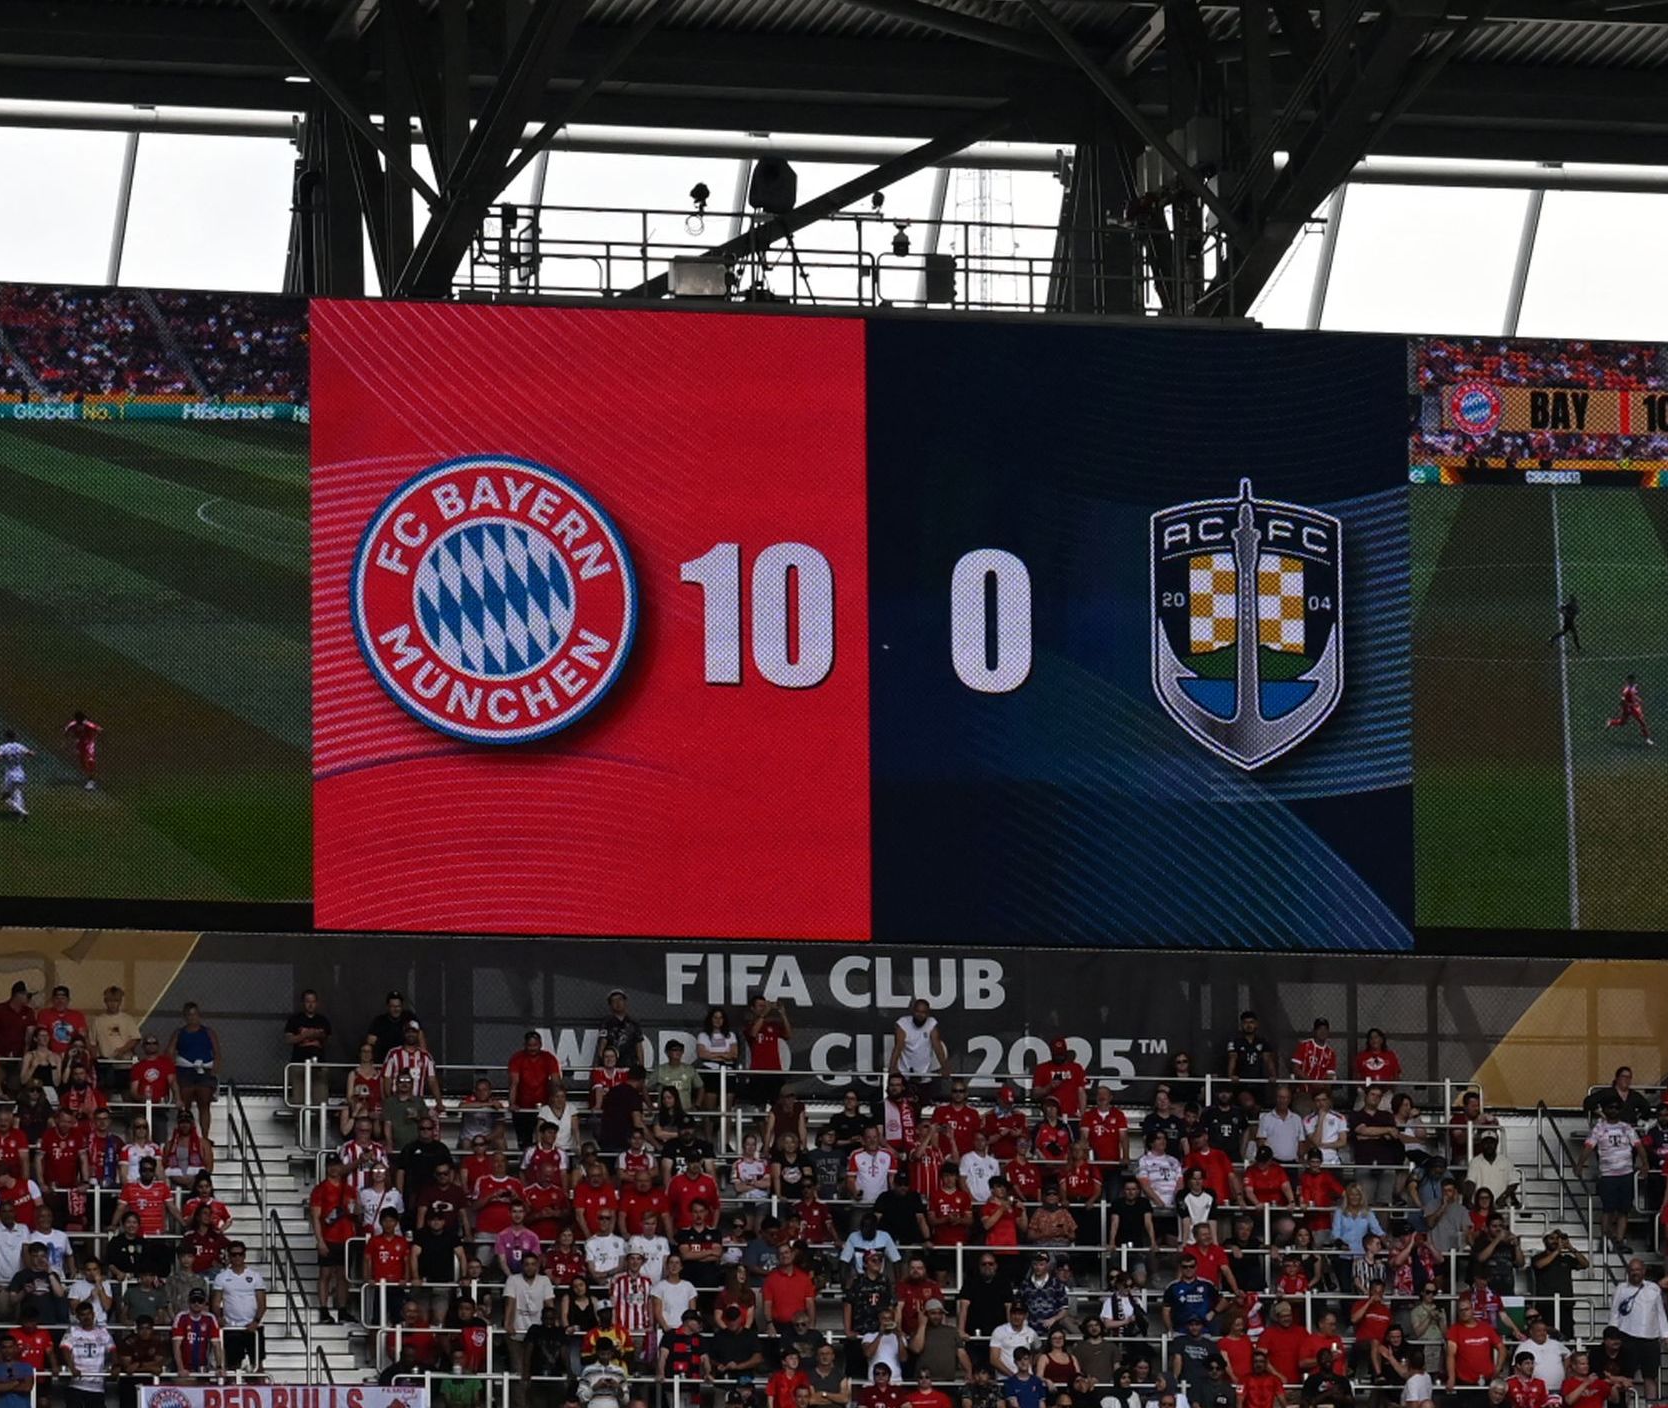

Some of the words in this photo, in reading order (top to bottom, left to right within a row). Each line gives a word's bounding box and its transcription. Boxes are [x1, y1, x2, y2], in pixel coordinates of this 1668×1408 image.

[14, 403, 77, 420] Global
[181, 403, 274, 420] Hisense
[1532, 392, 1589, 430] BAY
[376, 511, 429, 576] FC
[431, 475, 612, 582] BAYERN
[680, 541, 834, 688] 10
[950, 548, 1032, 693] 0
[1161, 592, 1186, 609] 20
[1307, 595, 1332, 611] 04
[378, 623, 611, 724] MÜNCHEN
[665, 952, 812, 1007] FIFA
[829, 955, 1006, 1011] CLUB
[809, 1032, 948, 1091] CU
